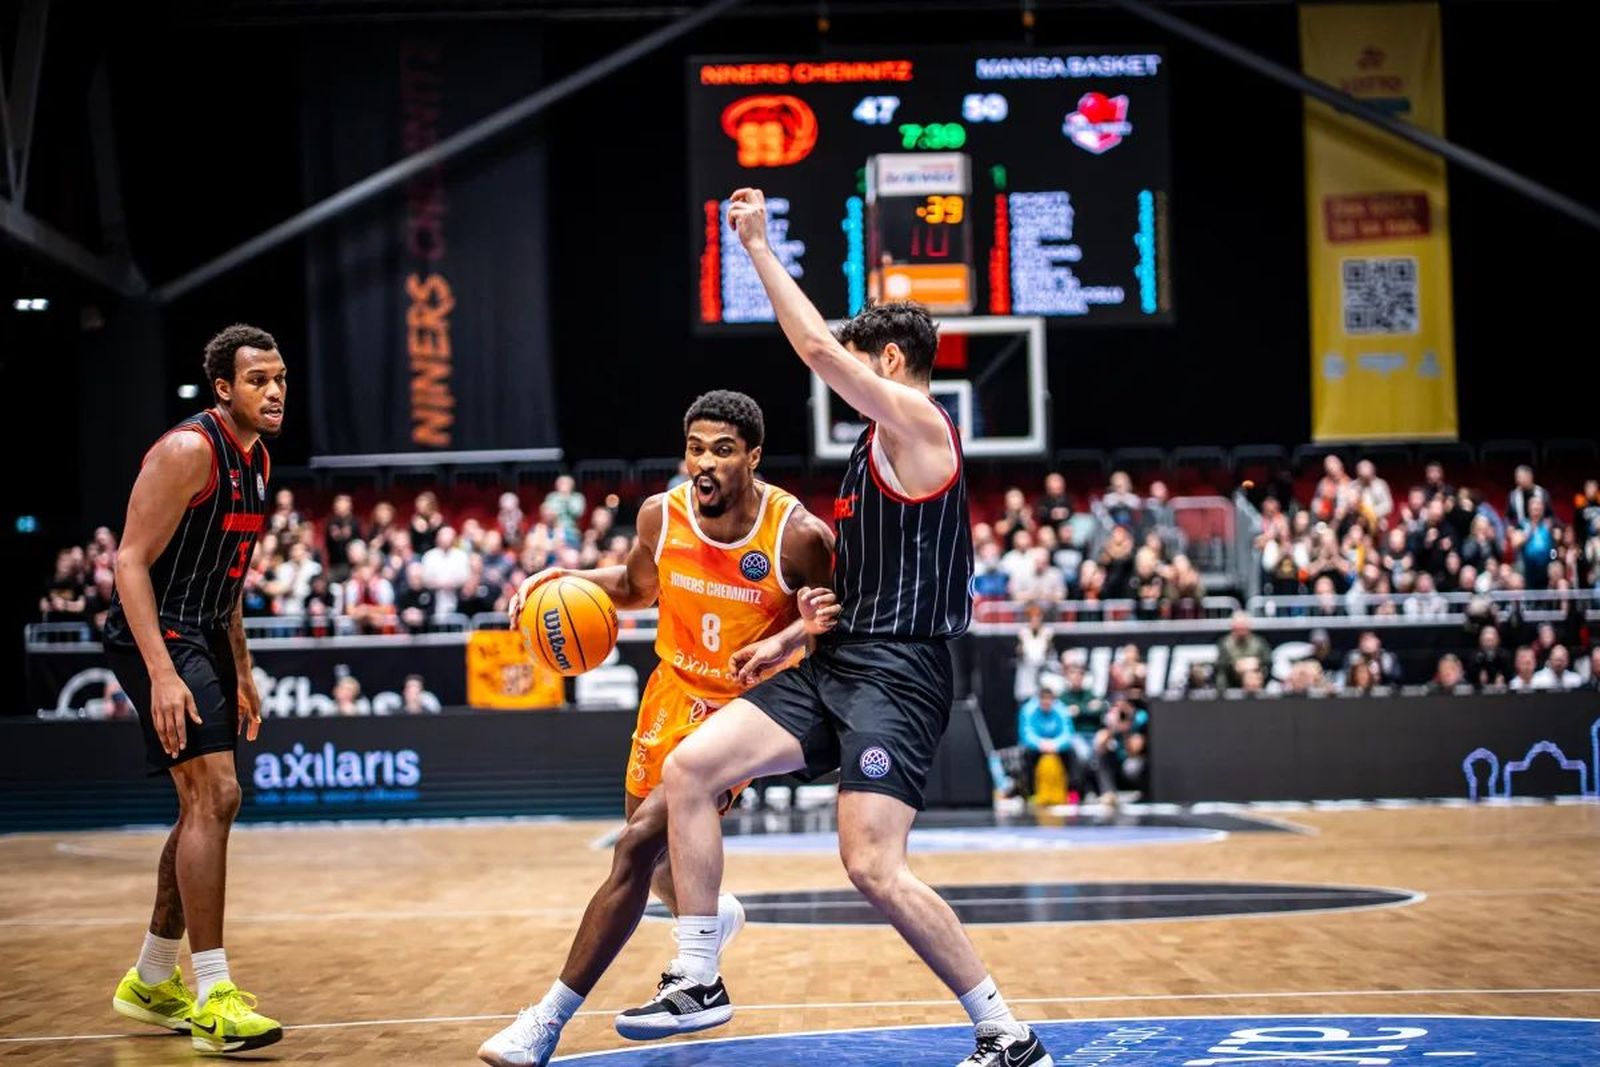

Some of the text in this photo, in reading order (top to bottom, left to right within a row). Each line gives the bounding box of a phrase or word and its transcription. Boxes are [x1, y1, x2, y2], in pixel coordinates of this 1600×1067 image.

[852, 96, 900, 125] 47
[405, 273, 455, 447] NINERS
[706, 581, 762, 605] CHEMNITZ
[543, 608, 572, 670] Wilson
[702, 613, 721, 653] 8
[254, 742, 421, 789] axilaris
